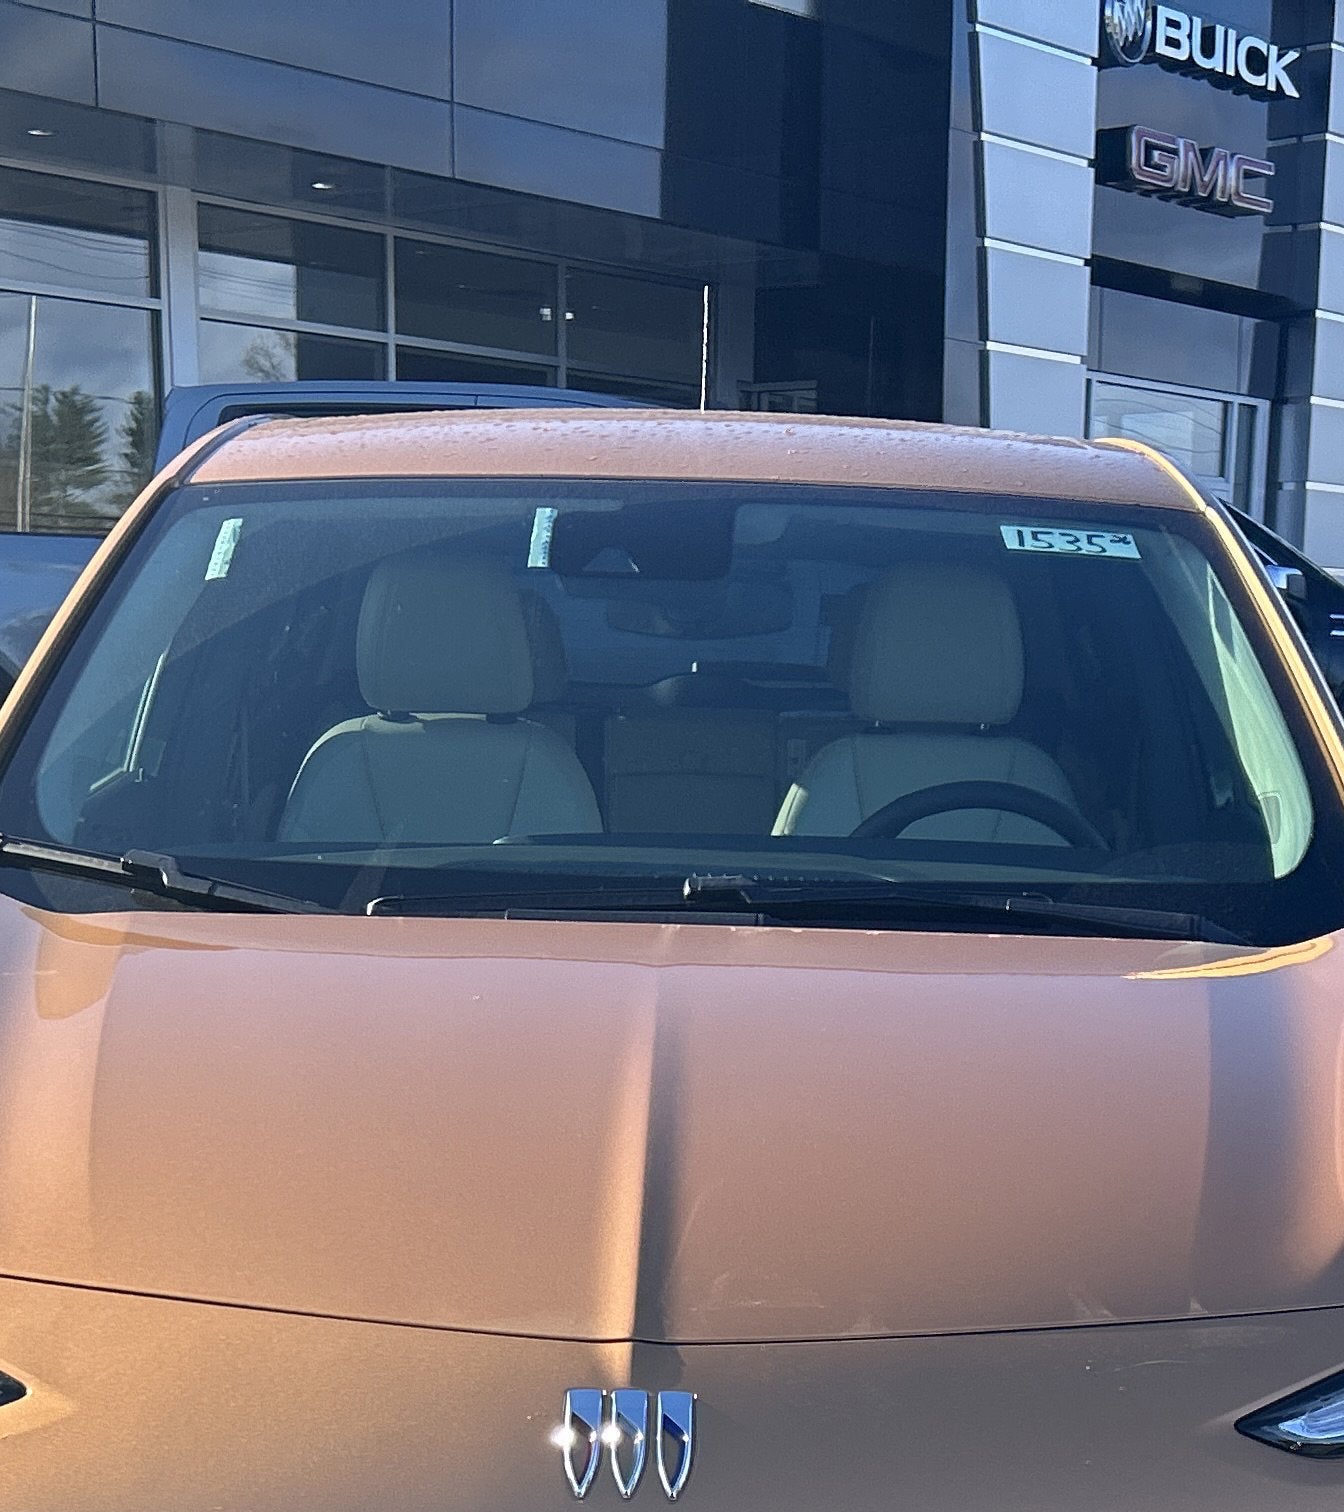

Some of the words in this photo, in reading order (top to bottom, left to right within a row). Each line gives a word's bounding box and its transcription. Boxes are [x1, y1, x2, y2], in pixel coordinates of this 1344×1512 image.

[1155, 5, 1301, 99] BUICK
[1131, 125, 1275, 214] GMC
[1015, 528, 1108, 554] 1535
